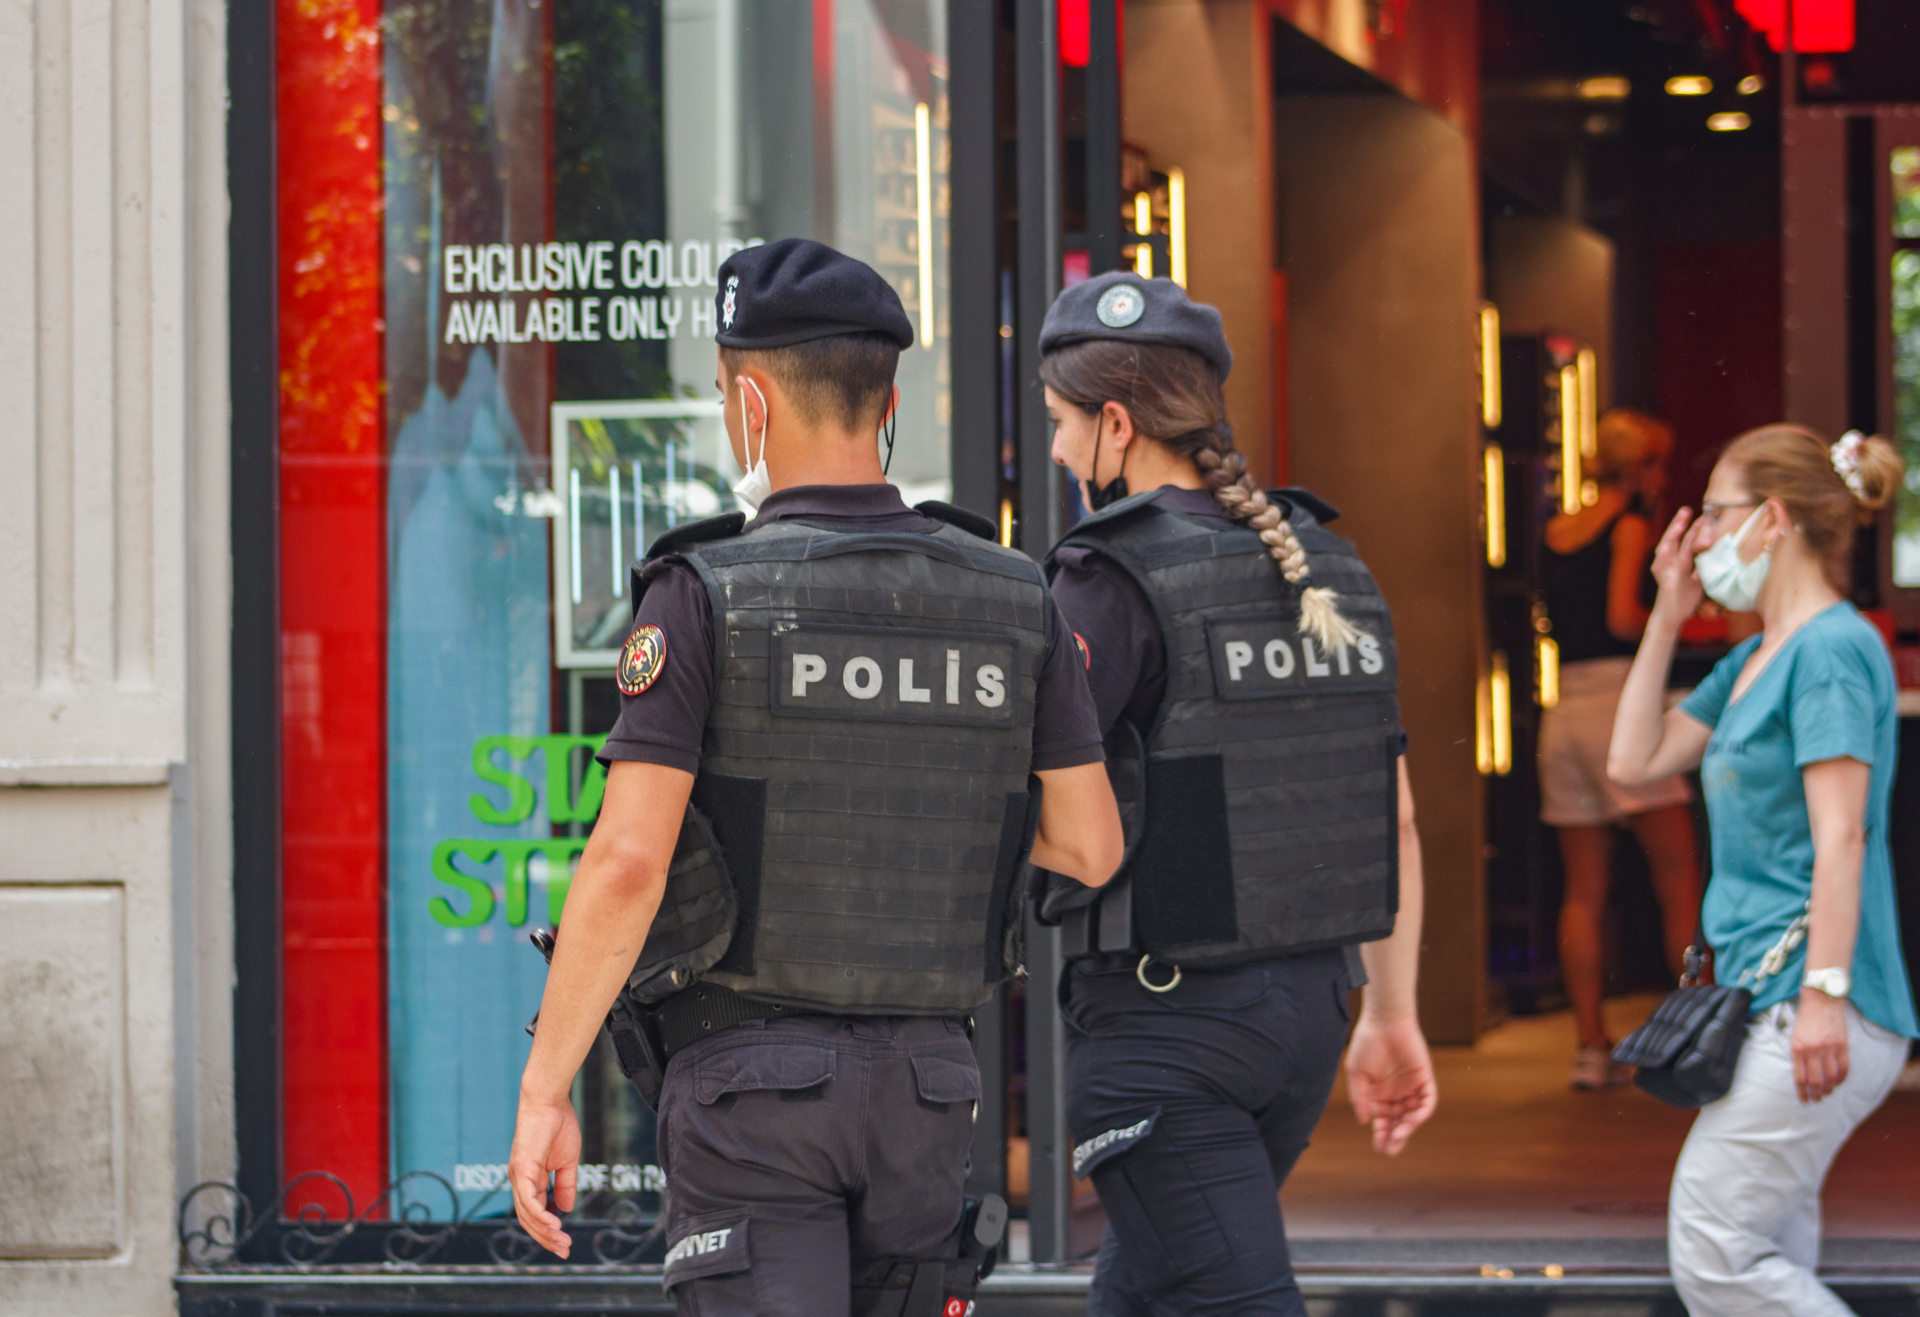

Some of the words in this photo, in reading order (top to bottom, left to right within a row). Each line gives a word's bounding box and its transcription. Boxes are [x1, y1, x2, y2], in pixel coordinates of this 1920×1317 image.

[445, 241, 615, 293] EXCLUSIVE
[621, 238, 766, 290] COLOU
[445, 297, 601, 344] AVAILABLE
[607, 296, 683, 341] ONLY
[792, 648, 1006, 708] POLİS
